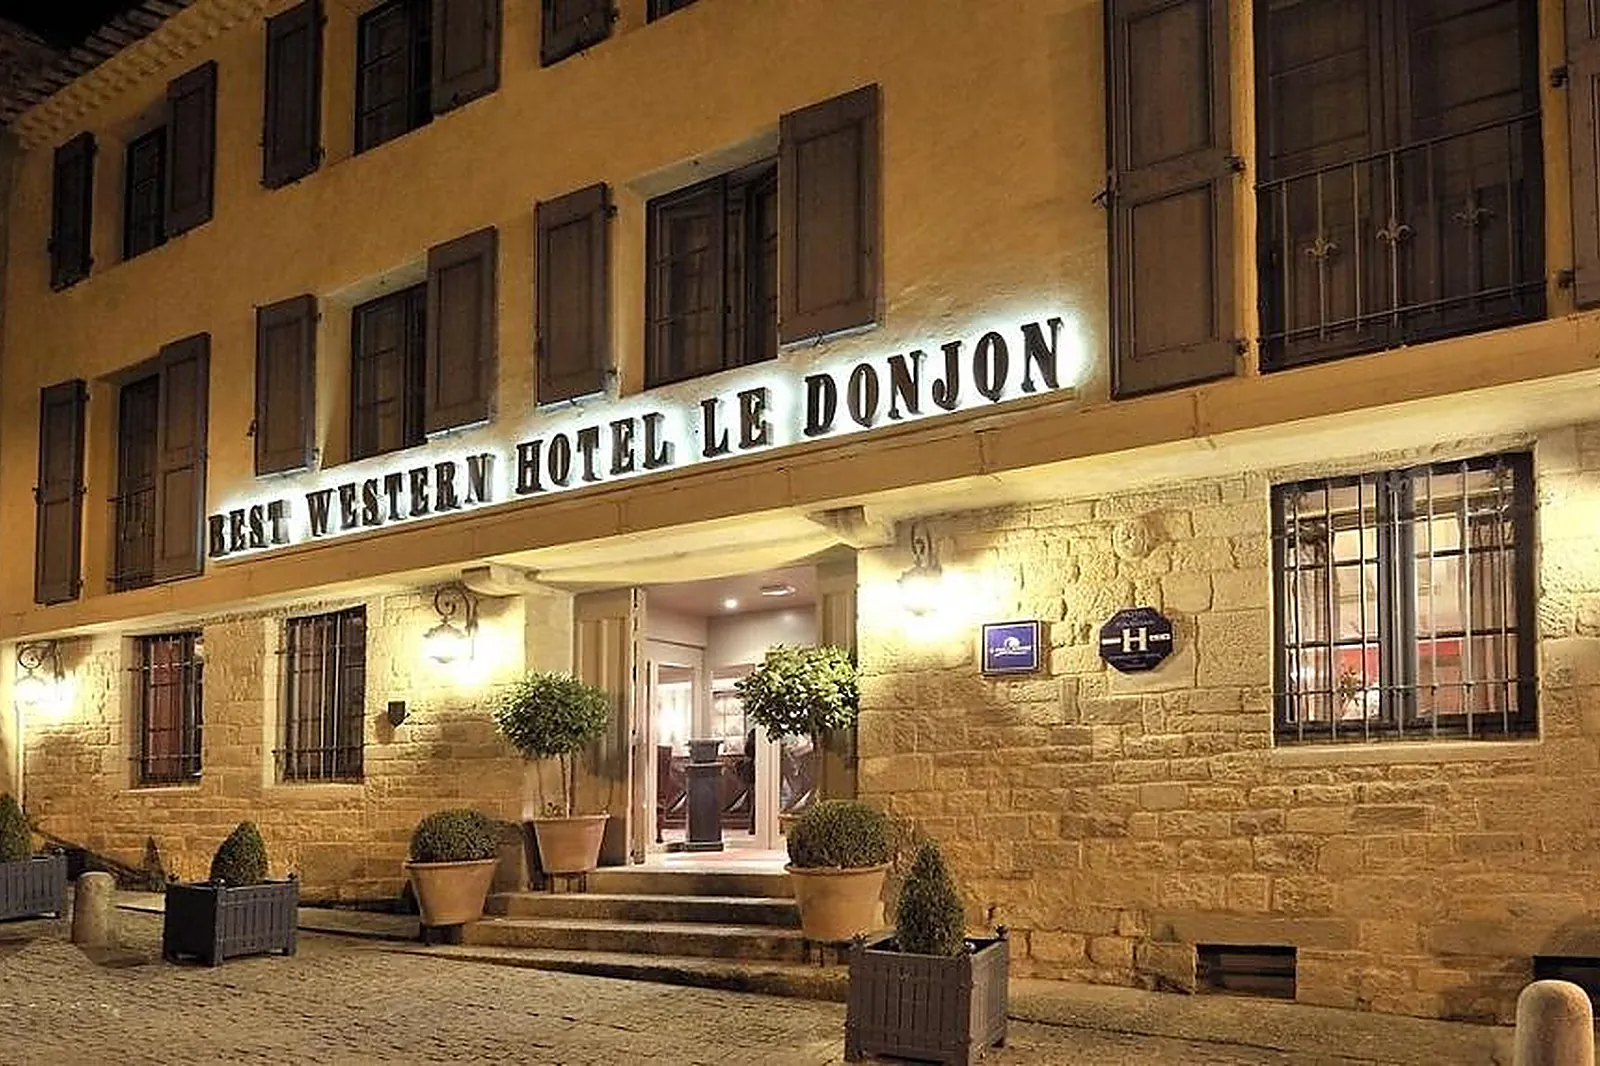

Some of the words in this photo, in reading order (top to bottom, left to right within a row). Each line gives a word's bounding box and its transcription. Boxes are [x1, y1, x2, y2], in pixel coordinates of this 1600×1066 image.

[209, 500, 289, 557] BEST
[306, 453, 495, 537] WESTERN
[515, 412, 675, 494] HOTEL
[701, 387, 773, 457] LE
[803, 317, 1064, 437] DONJON
[1121, 626, 1148, 653] H
